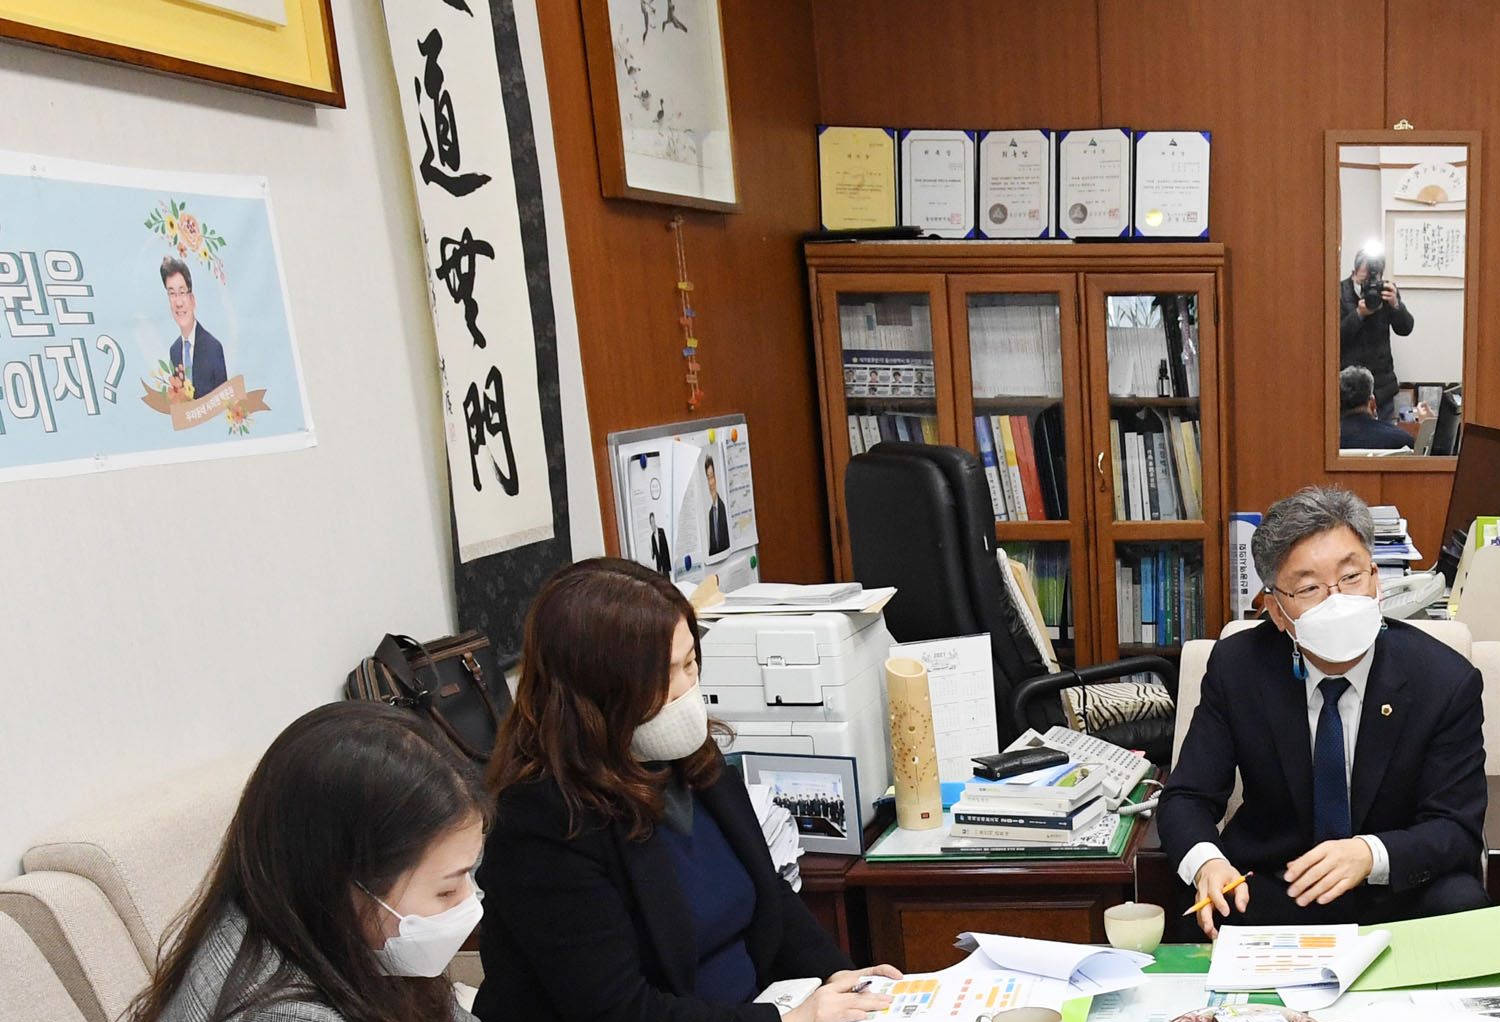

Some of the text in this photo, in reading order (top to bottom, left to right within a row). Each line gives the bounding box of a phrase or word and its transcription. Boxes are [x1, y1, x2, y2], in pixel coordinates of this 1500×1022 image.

[414, 0, 519, 497] 道無門
[0, 333, 125, 435] 이지?
[1238, 543, 1248, 595] 울산광역시의회
